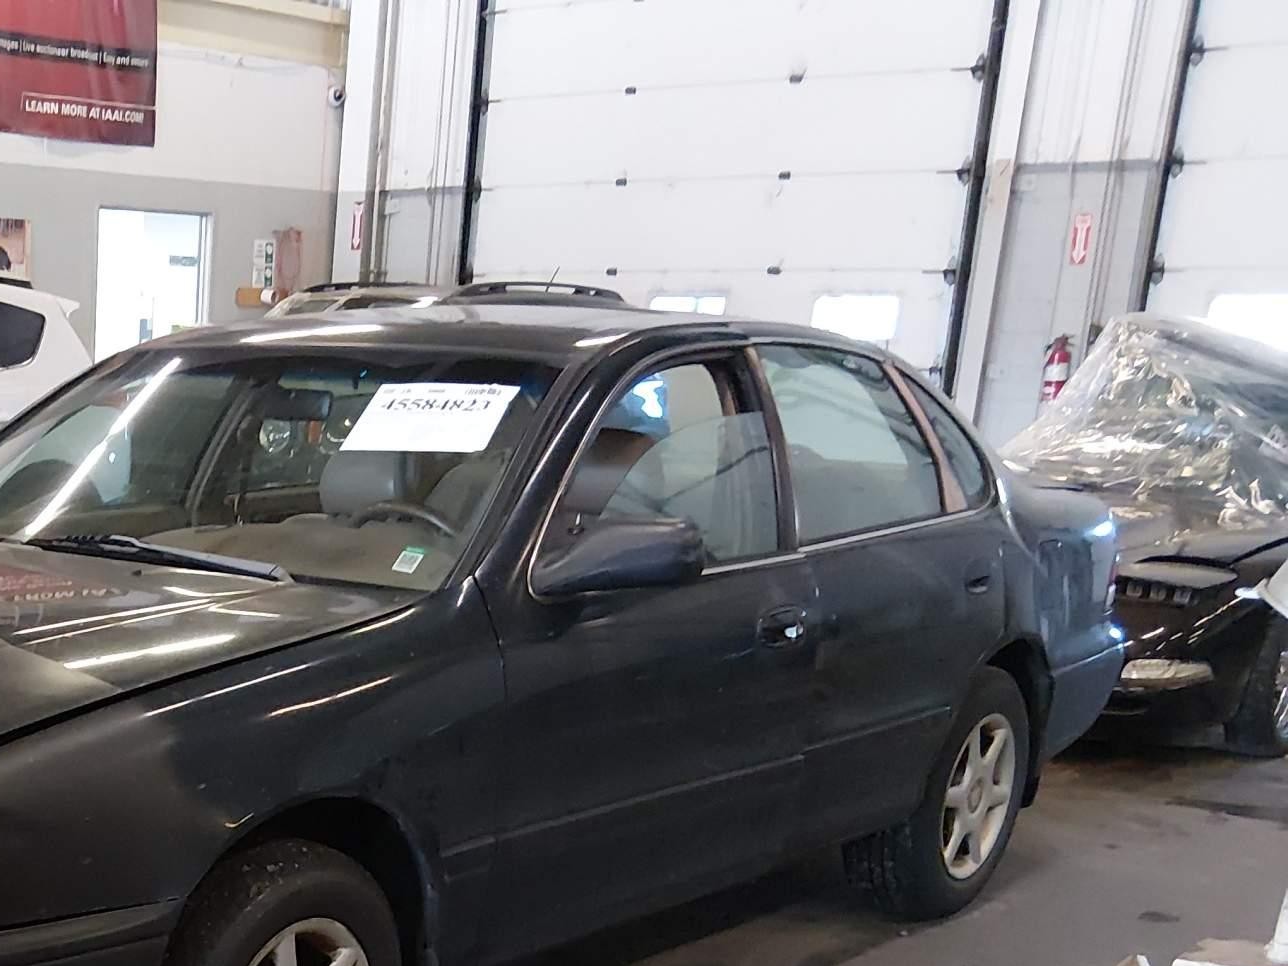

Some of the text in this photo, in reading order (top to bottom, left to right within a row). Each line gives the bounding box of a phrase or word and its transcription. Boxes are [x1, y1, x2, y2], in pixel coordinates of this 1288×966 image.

[116, 56, 130, 66] and
[25, 99, 145, 125] LEARN MORE AT IAAI.COM
